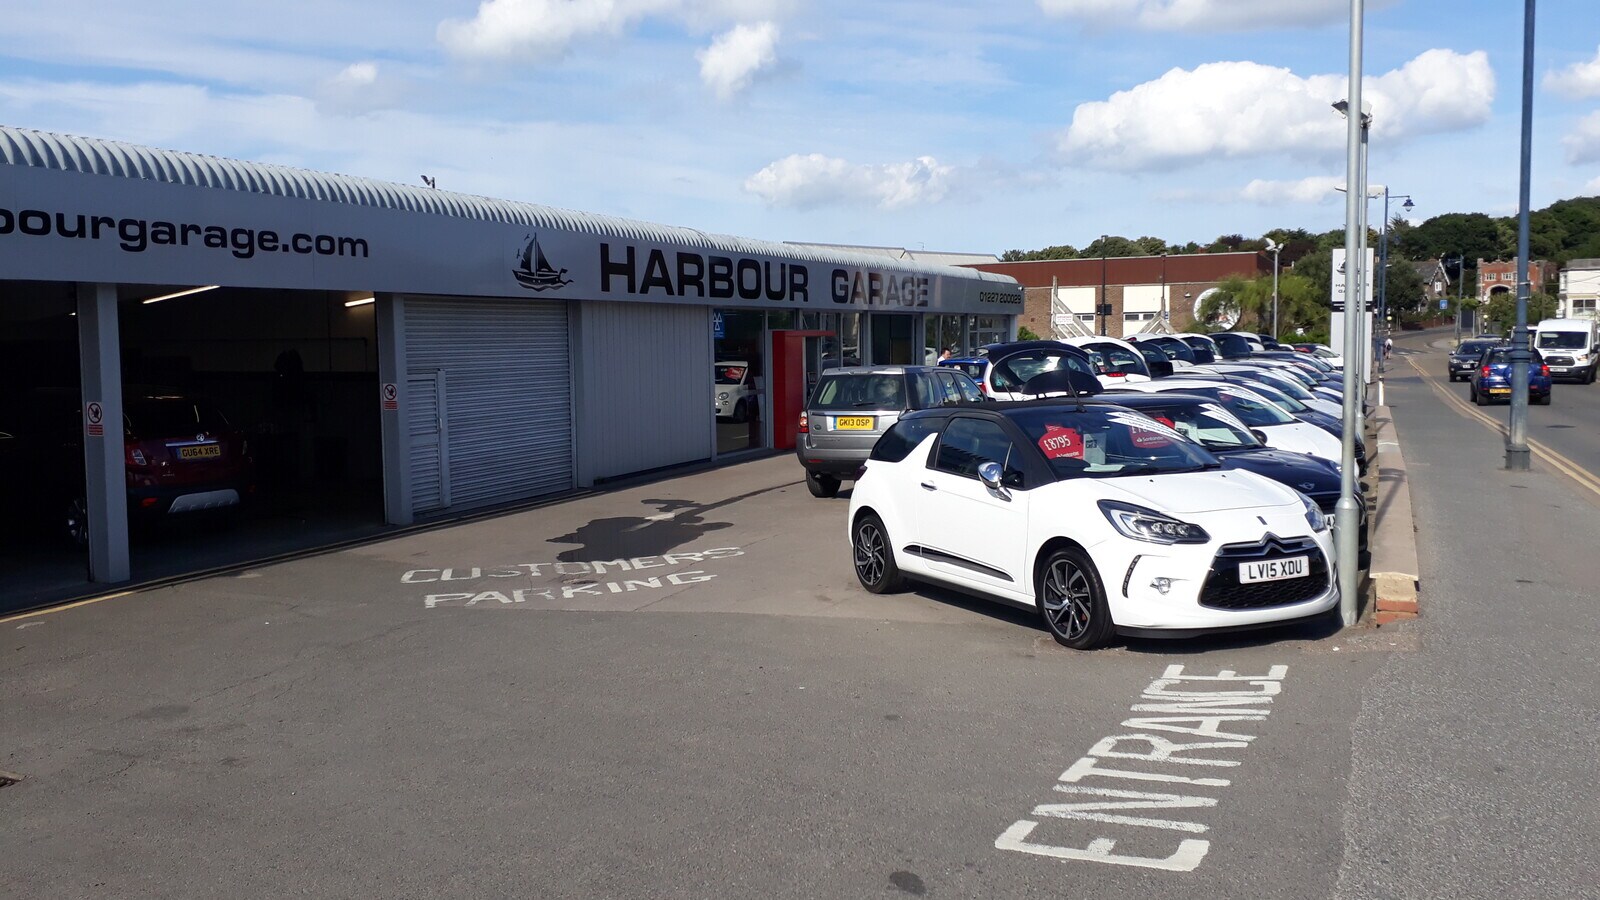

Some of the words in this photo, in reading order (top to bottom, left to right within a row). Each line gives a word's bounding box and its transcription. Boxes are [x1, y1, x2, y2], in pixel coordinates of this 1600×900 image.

[600, 243, 809, 302] HARBOUR
[831, 269, 929, 307] GARAGE
[980, 291, 998, 302] 01227
[855, 418, 870, 426] OSP
[182, 448, 202, 457] GU64
[204, 446, 219, 455] XRE
[1043, 434, 1071, 451] £8795
[400, 547, 745, 584] CUSTOMERS
[1248, 562, 1277, 579] LV15
[1280, 559, 1302, 577] XDU
[424, 570, 718, 608] PARKING
[994, 664, 1289, 872] ENTRANCE
